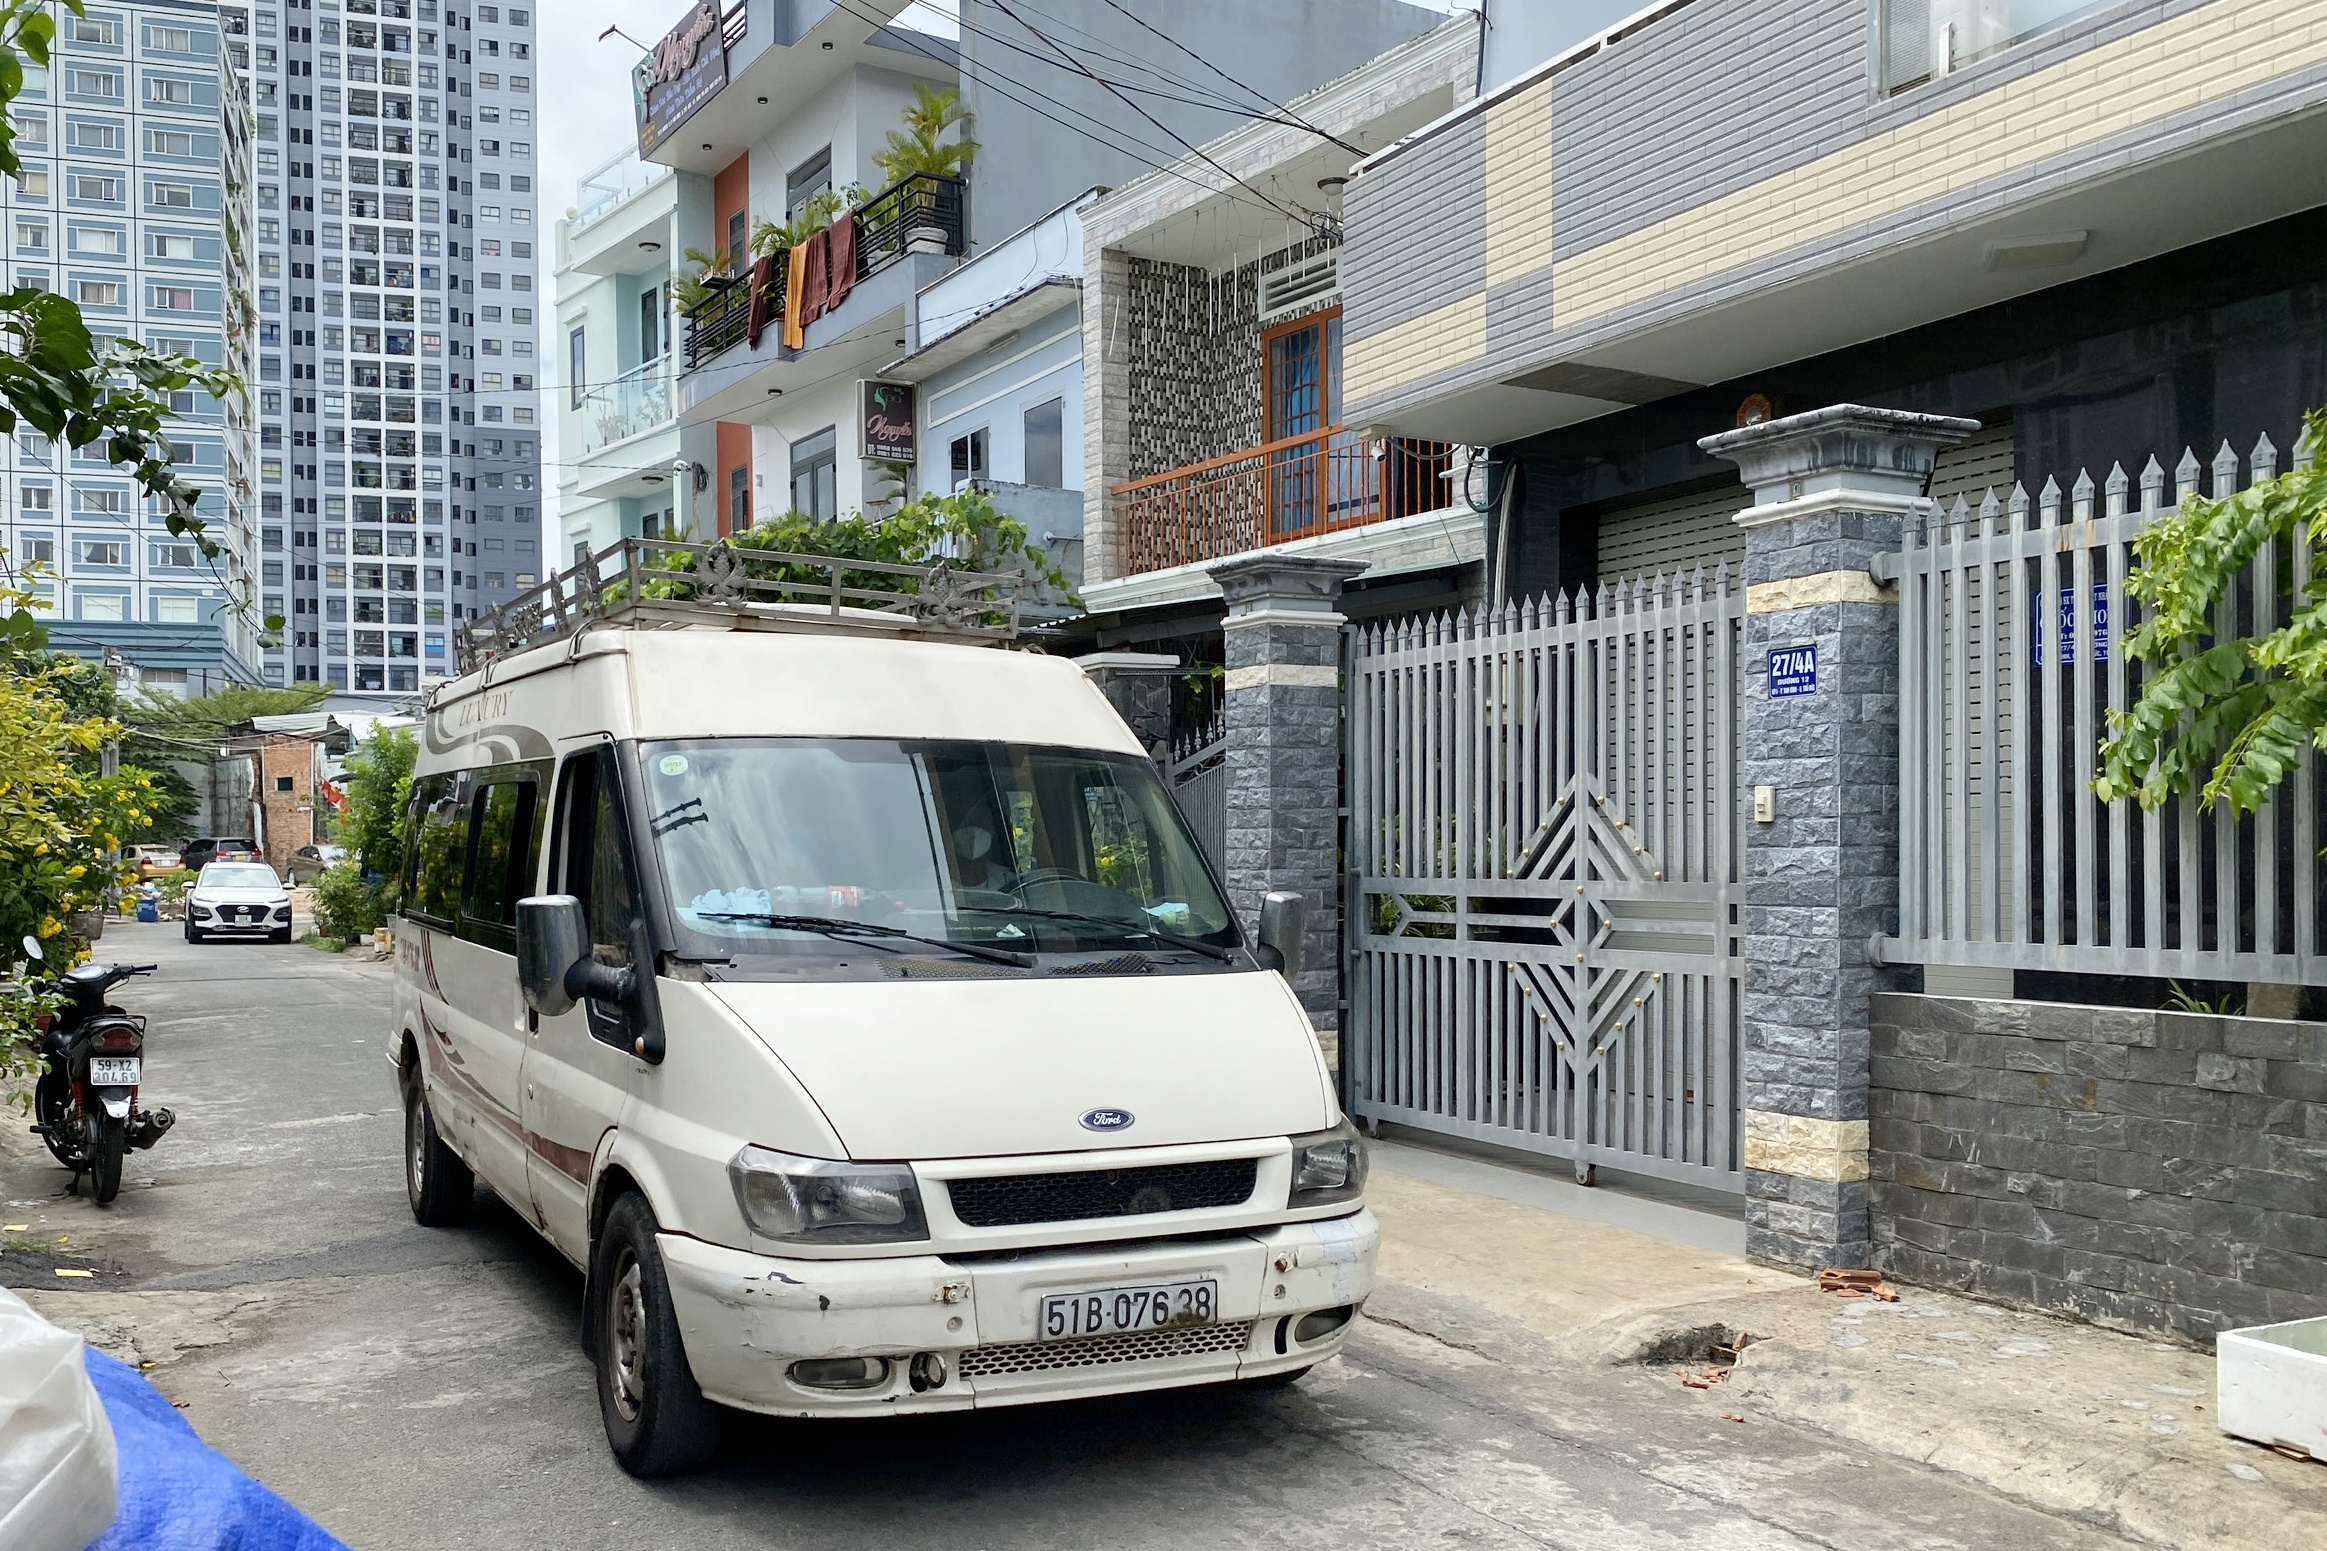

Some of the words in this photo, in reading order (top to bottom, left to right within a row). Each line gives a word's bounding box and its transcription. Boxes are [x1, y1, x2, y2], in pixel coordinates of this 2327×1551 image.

[1772, 651, 1814, 676] 27/4A
[459, 691, 512, 726] LUXURY
[98, 1060, 131, 1071] 59-X2
[1093, 1113, 1121, 1125] Ford
